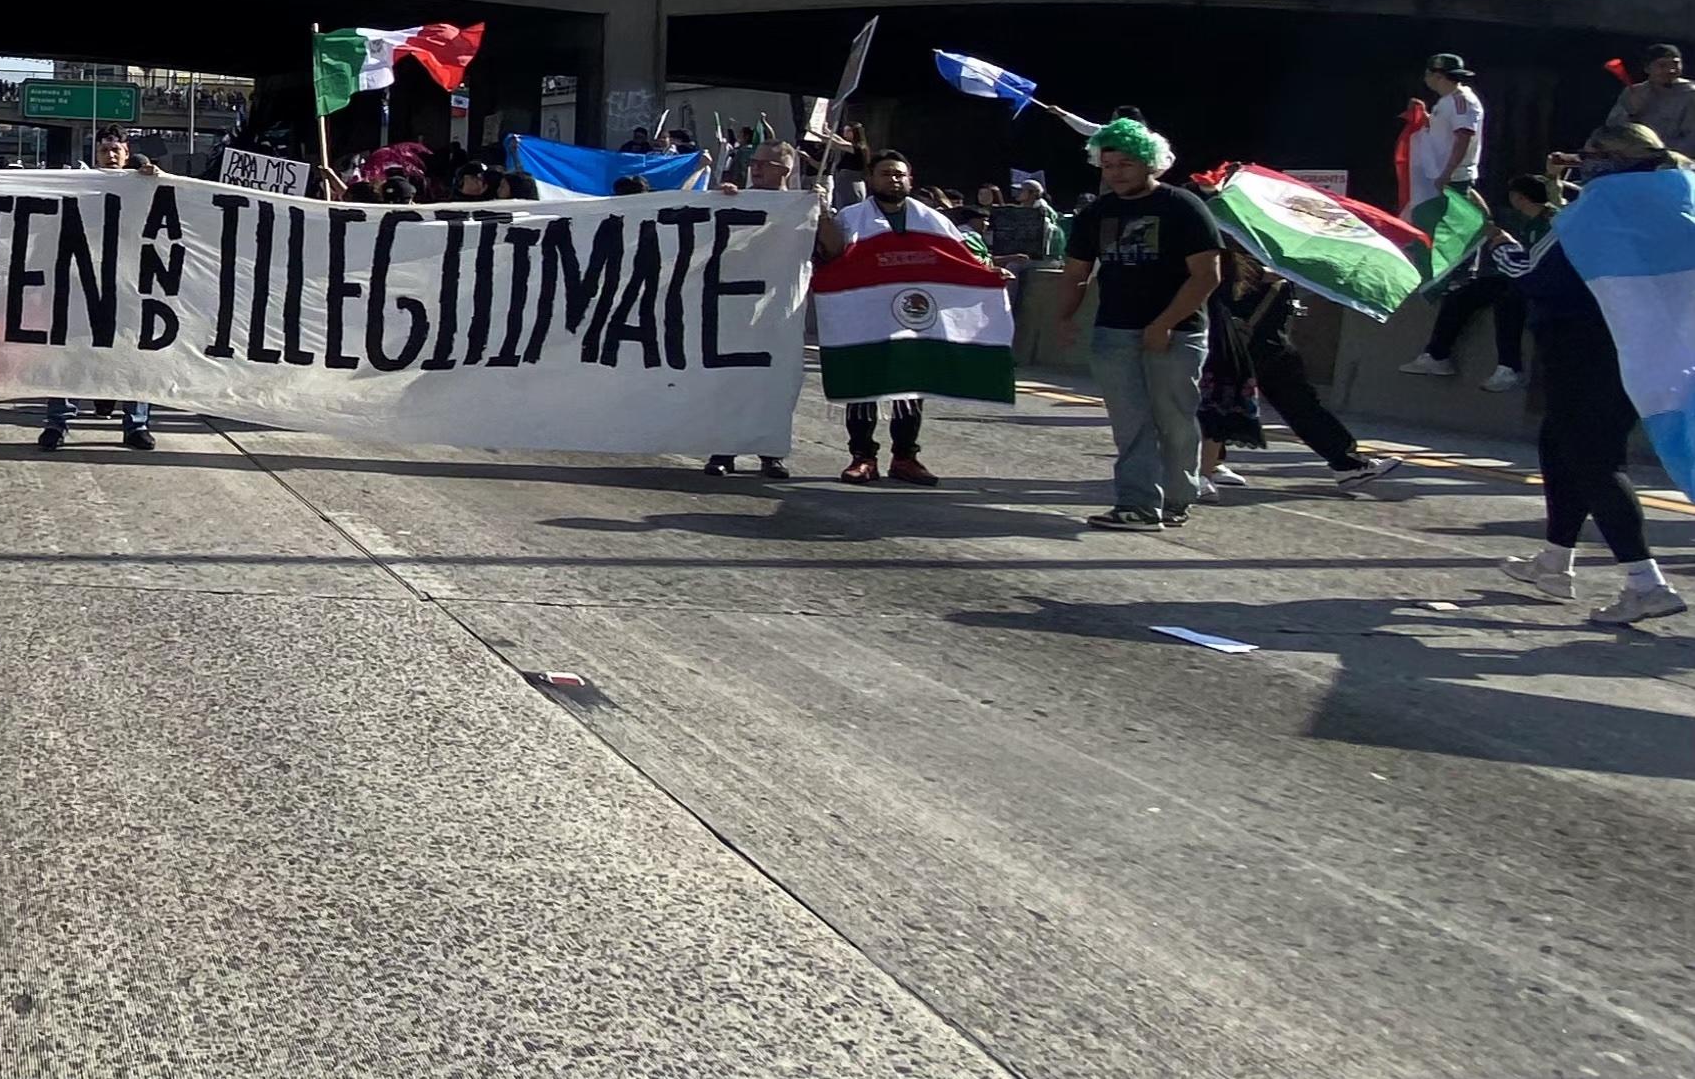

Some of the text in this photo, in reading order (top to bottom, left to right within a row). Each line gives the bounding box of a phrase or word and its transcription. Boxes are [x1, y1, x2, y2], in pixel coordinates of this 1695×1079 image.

[228, 151, 297, 185] PARA MIS
[137, 185, 186, 351] AND
[204, 192, 773, 373] ILLEGITIMATE
